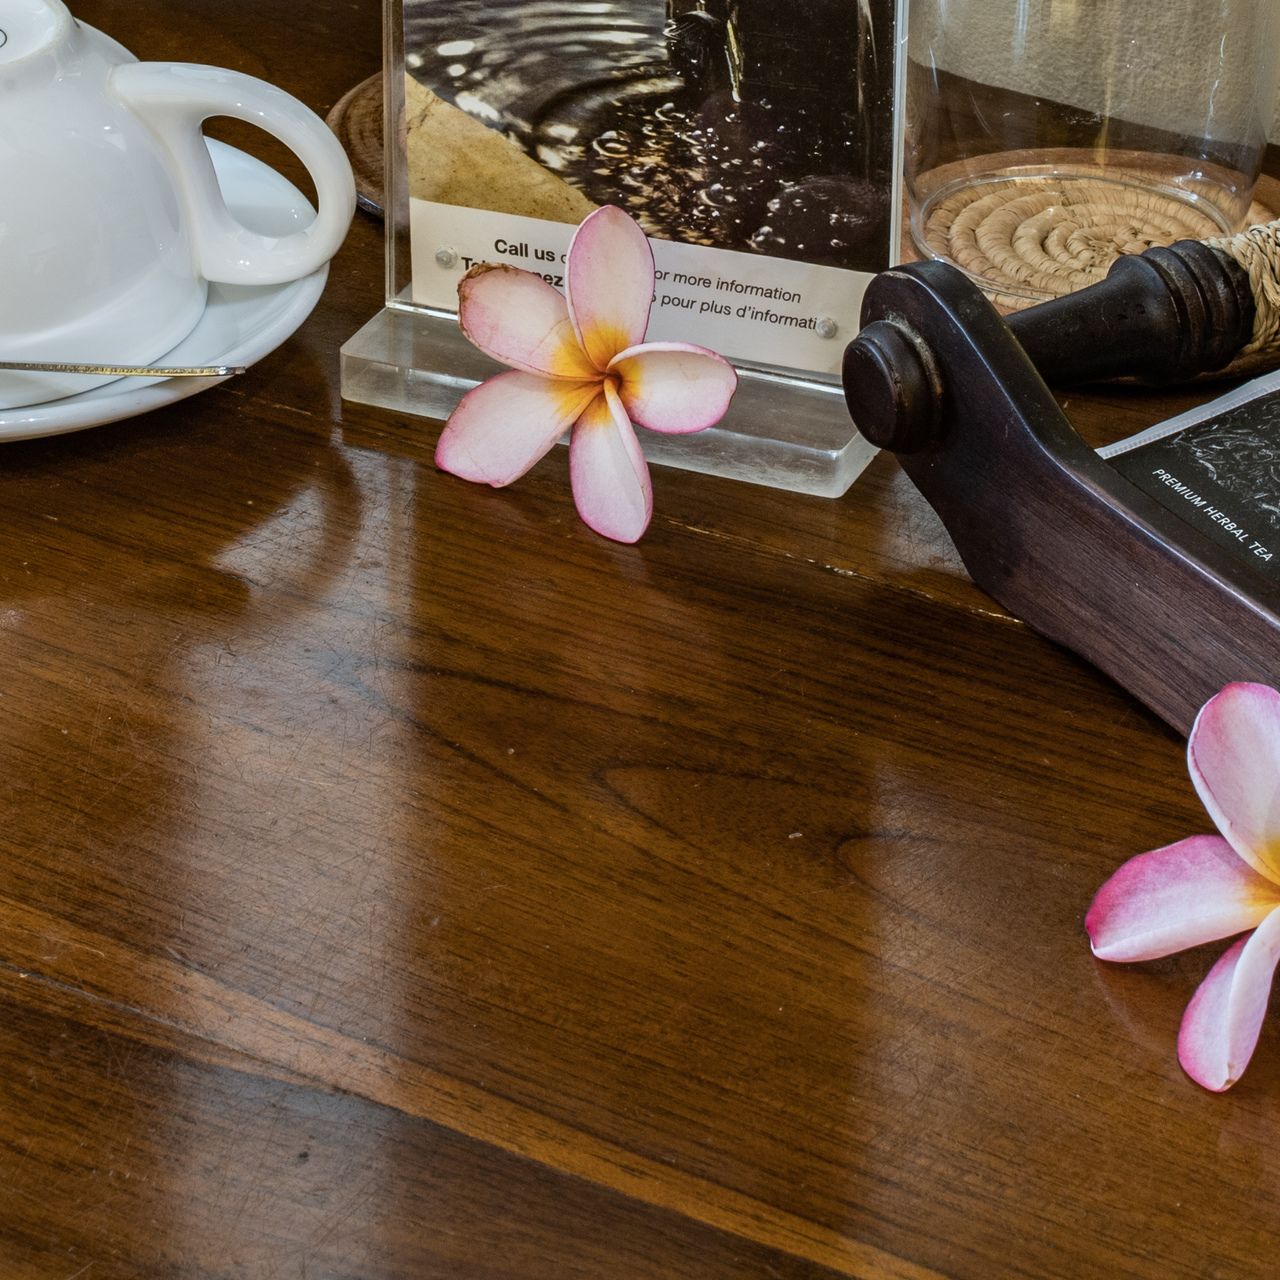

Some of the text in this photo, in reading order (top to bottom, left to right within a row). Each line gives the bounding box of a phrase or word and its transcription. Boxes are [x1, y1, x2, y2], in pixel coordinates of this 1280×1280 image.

[494, 239, 529, 258] Call
[534, 248, 556, 263] us
[654, 269, 802, 304] or more information
[660, 294, 697, 310] pour
[699, 300, 732, 317] plus
[736, 305, 817, 331] d’informati
[1151, 468, 1275, 562] PREMIUM HERBAL TEA
